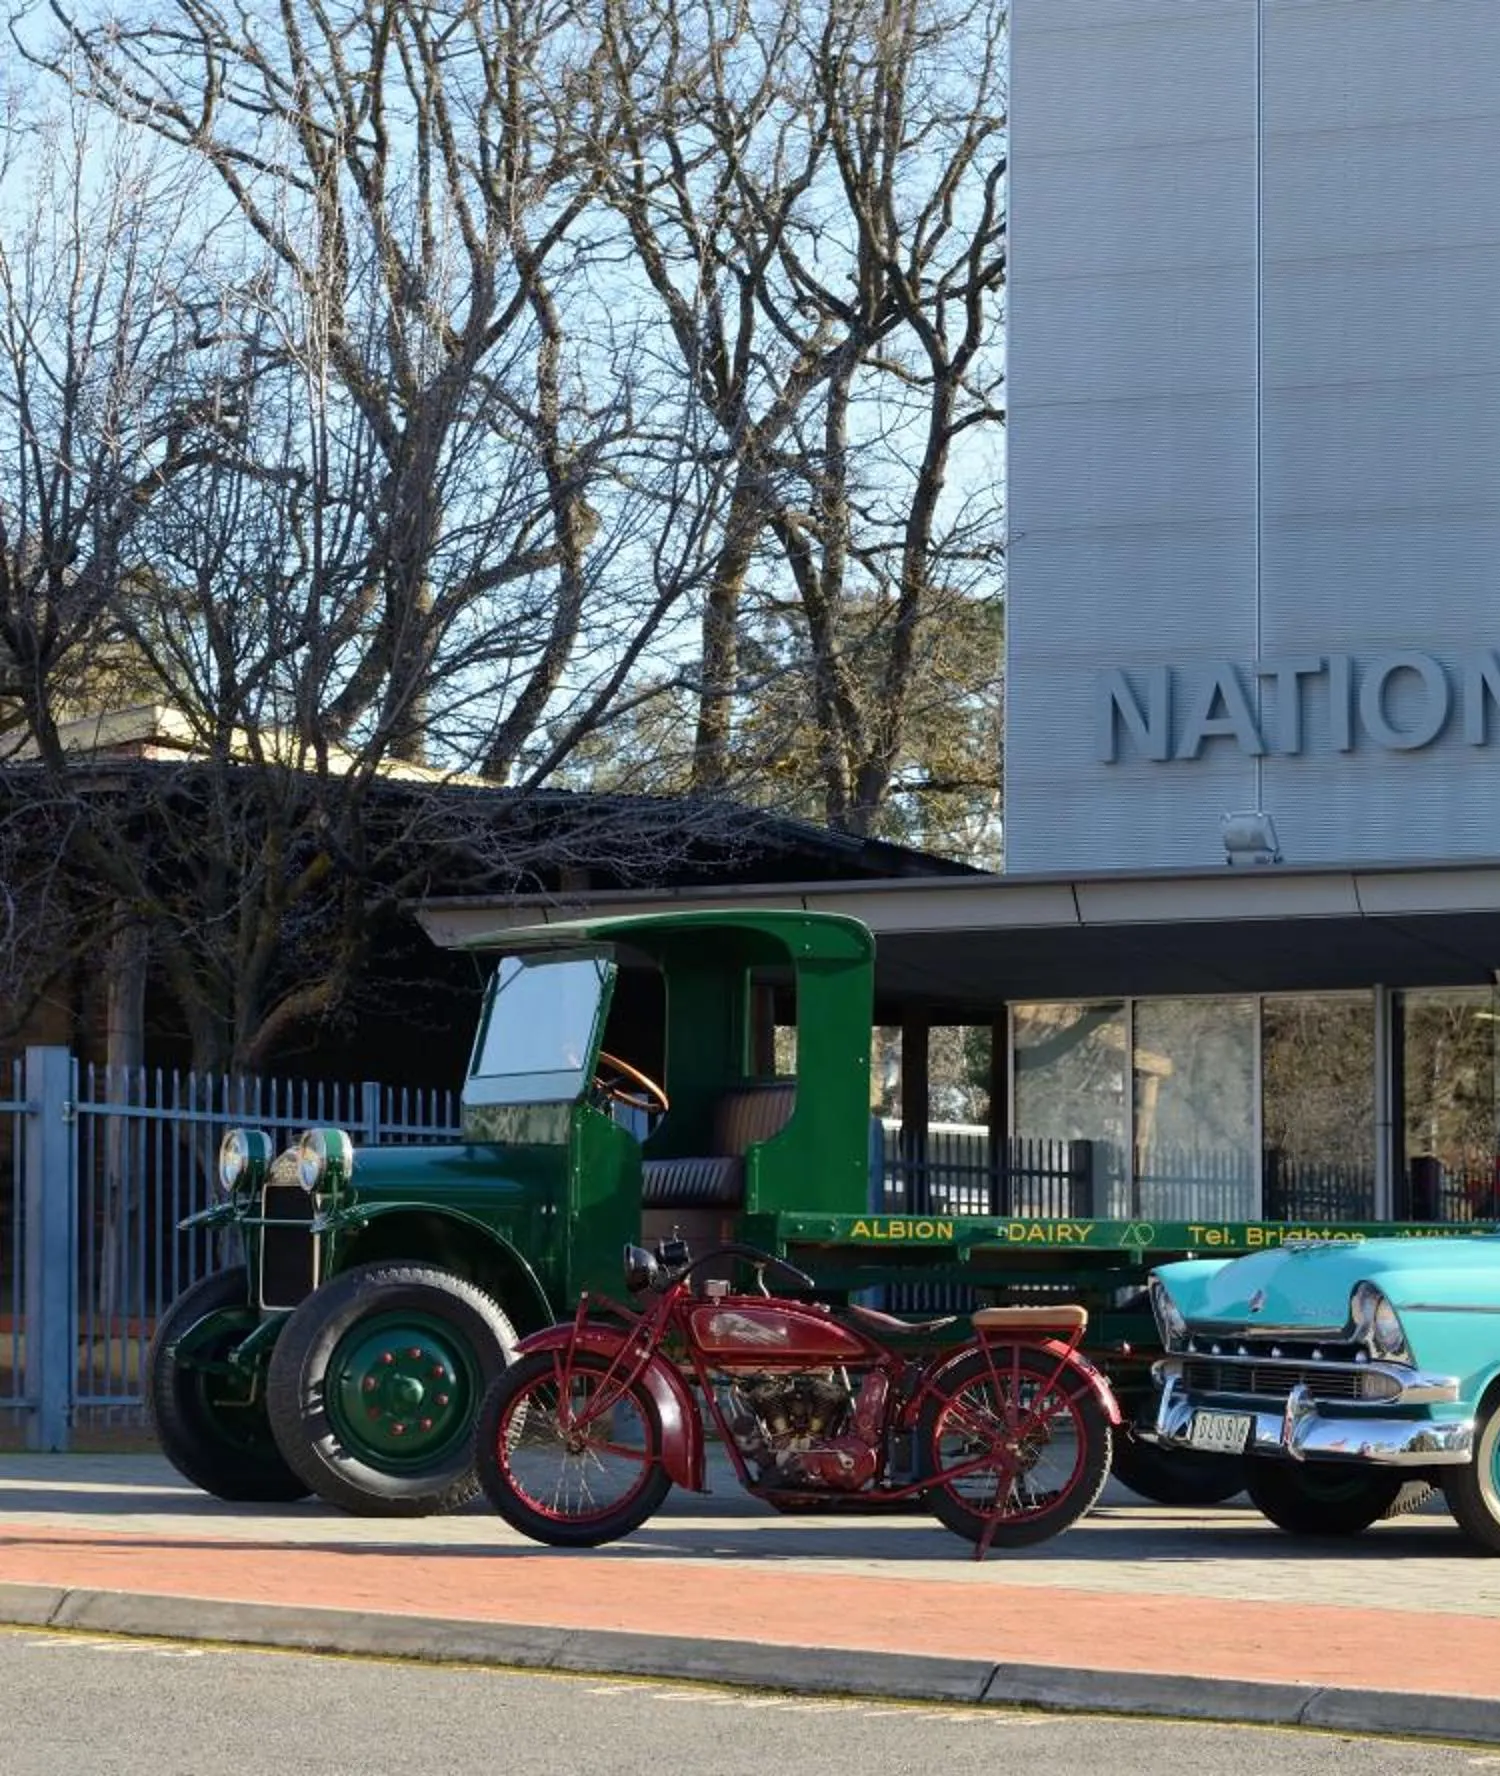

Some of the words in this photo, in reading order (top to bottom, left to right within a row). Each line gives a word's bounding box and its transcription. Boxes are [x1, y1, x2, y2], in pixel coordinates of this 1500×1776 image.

[850, 1220, 953, 1240] ALBION
[1007, 1223, 1094, 1243] DAIRY
[1188, 1225, 1235, 1246] Tel.
